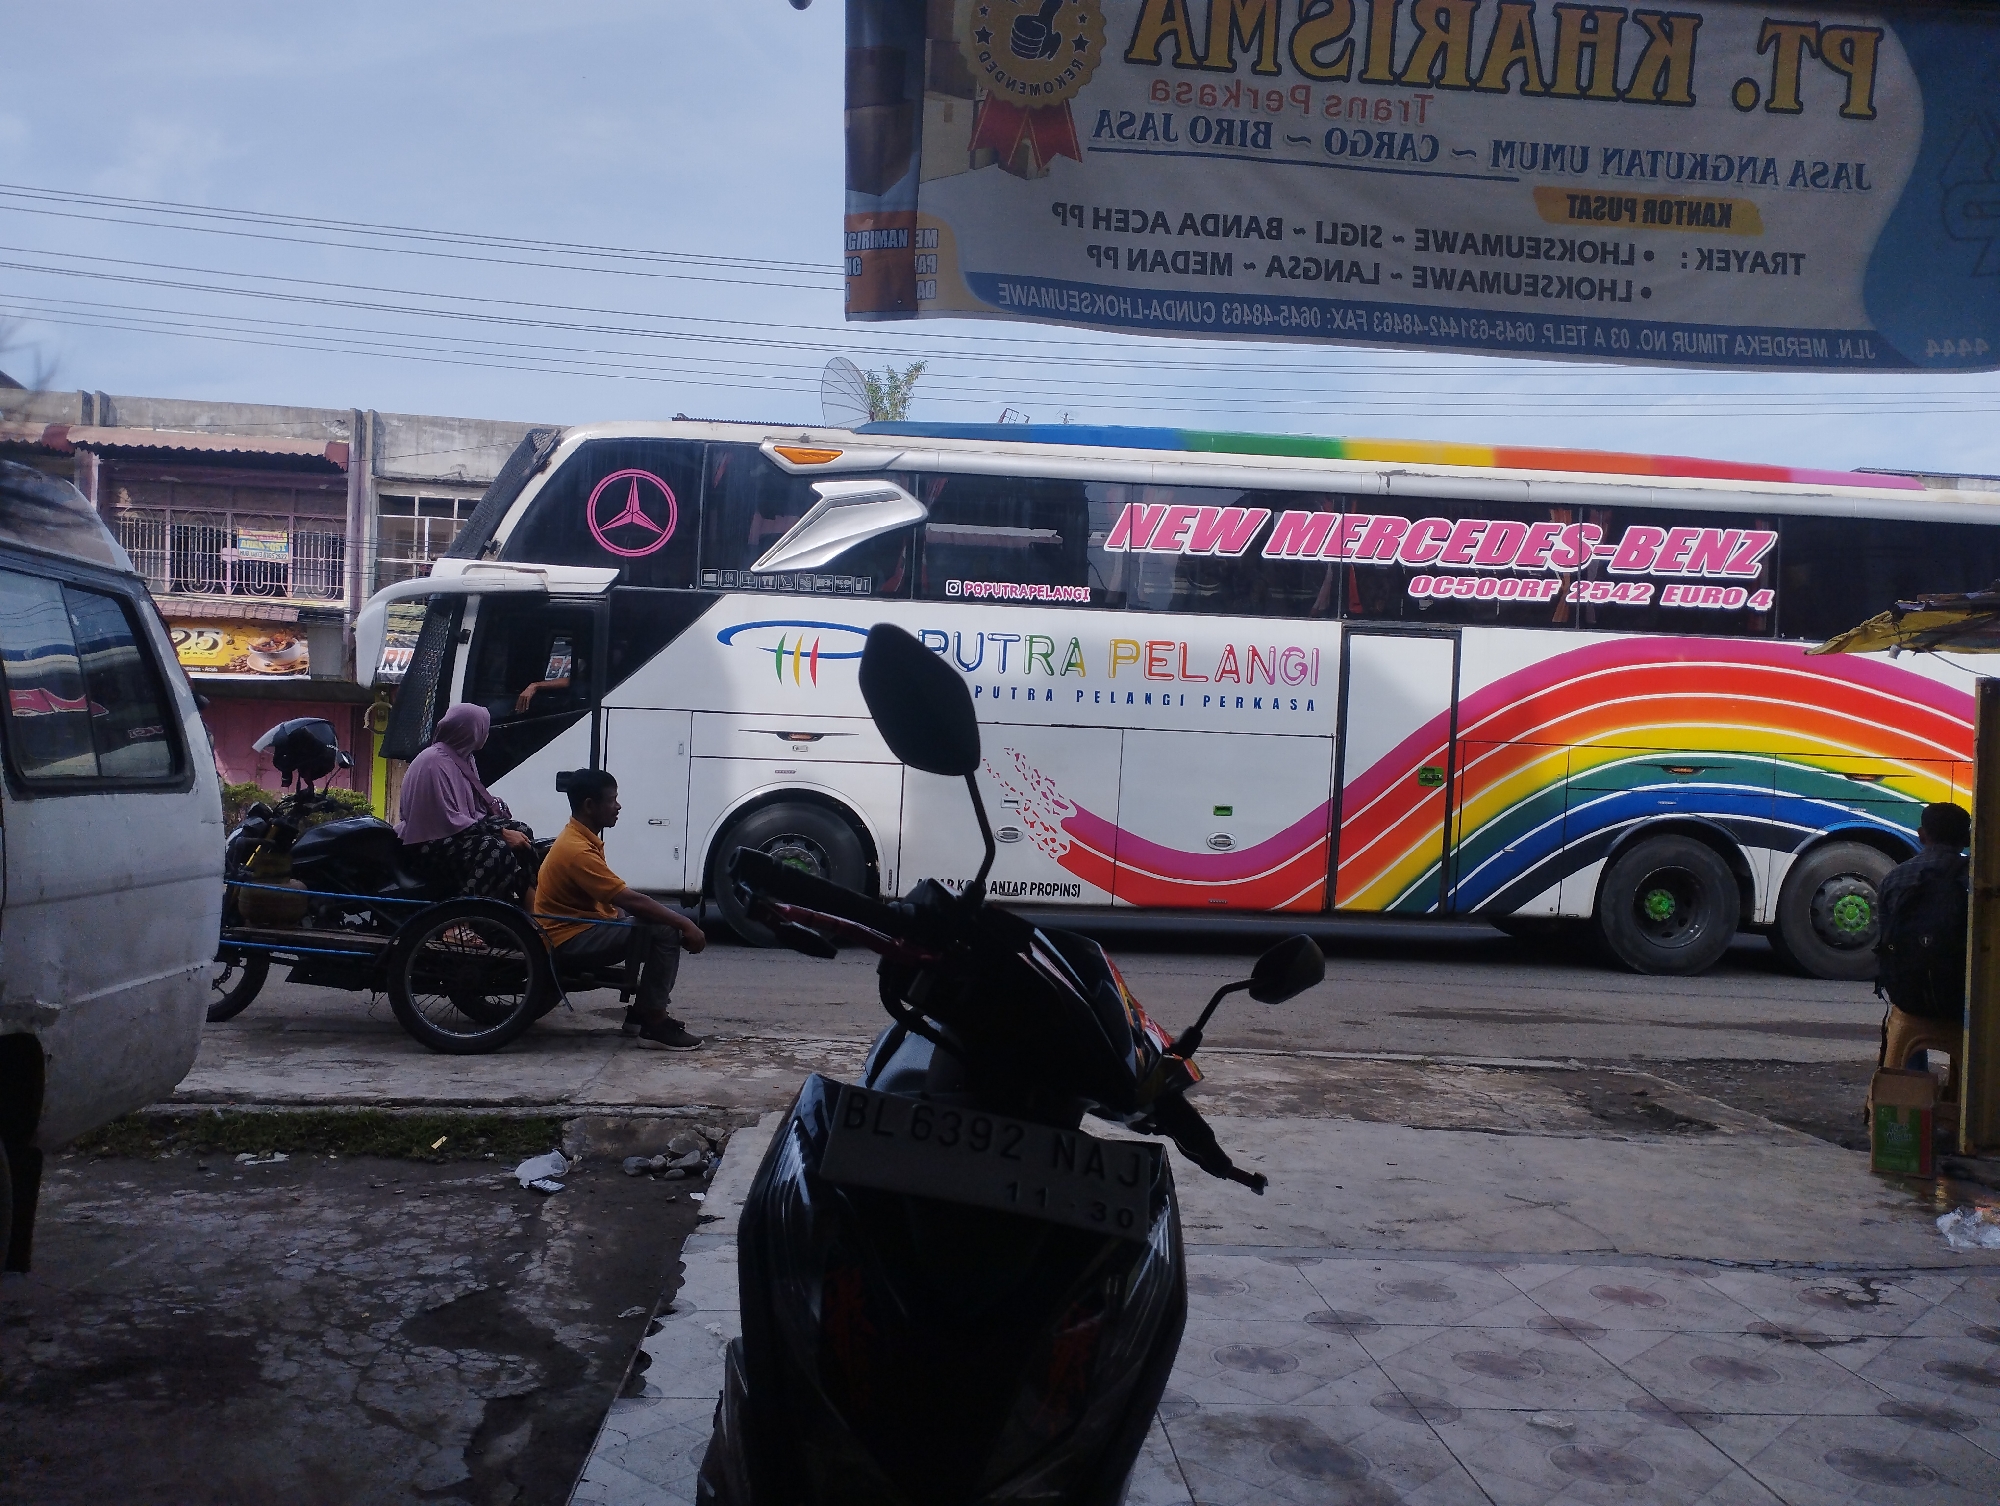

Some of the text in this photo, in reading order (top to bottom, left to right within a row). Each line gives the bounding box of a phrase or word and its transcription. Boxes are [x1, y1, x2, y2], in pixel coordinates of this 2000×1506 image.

[1103, 502, 1779, 578] NEW MERCEDES-BENZ
[963, 581, 1091, 602] POPUTRAPELANGI
[1408, 574, 1776, 612] OC500RF 2542 EURO 4
[917, 629, 1321, 687] PUTRA PELANGI
[974, 685, 1316, 712] PUTRA PELANGI PERKASA
[990, 880, 1028, 896] ANTAR
[1029, 882, 1081, 898] PROPINSI
[843, 1091, 1141, 1188] BL 6392 NAJ
